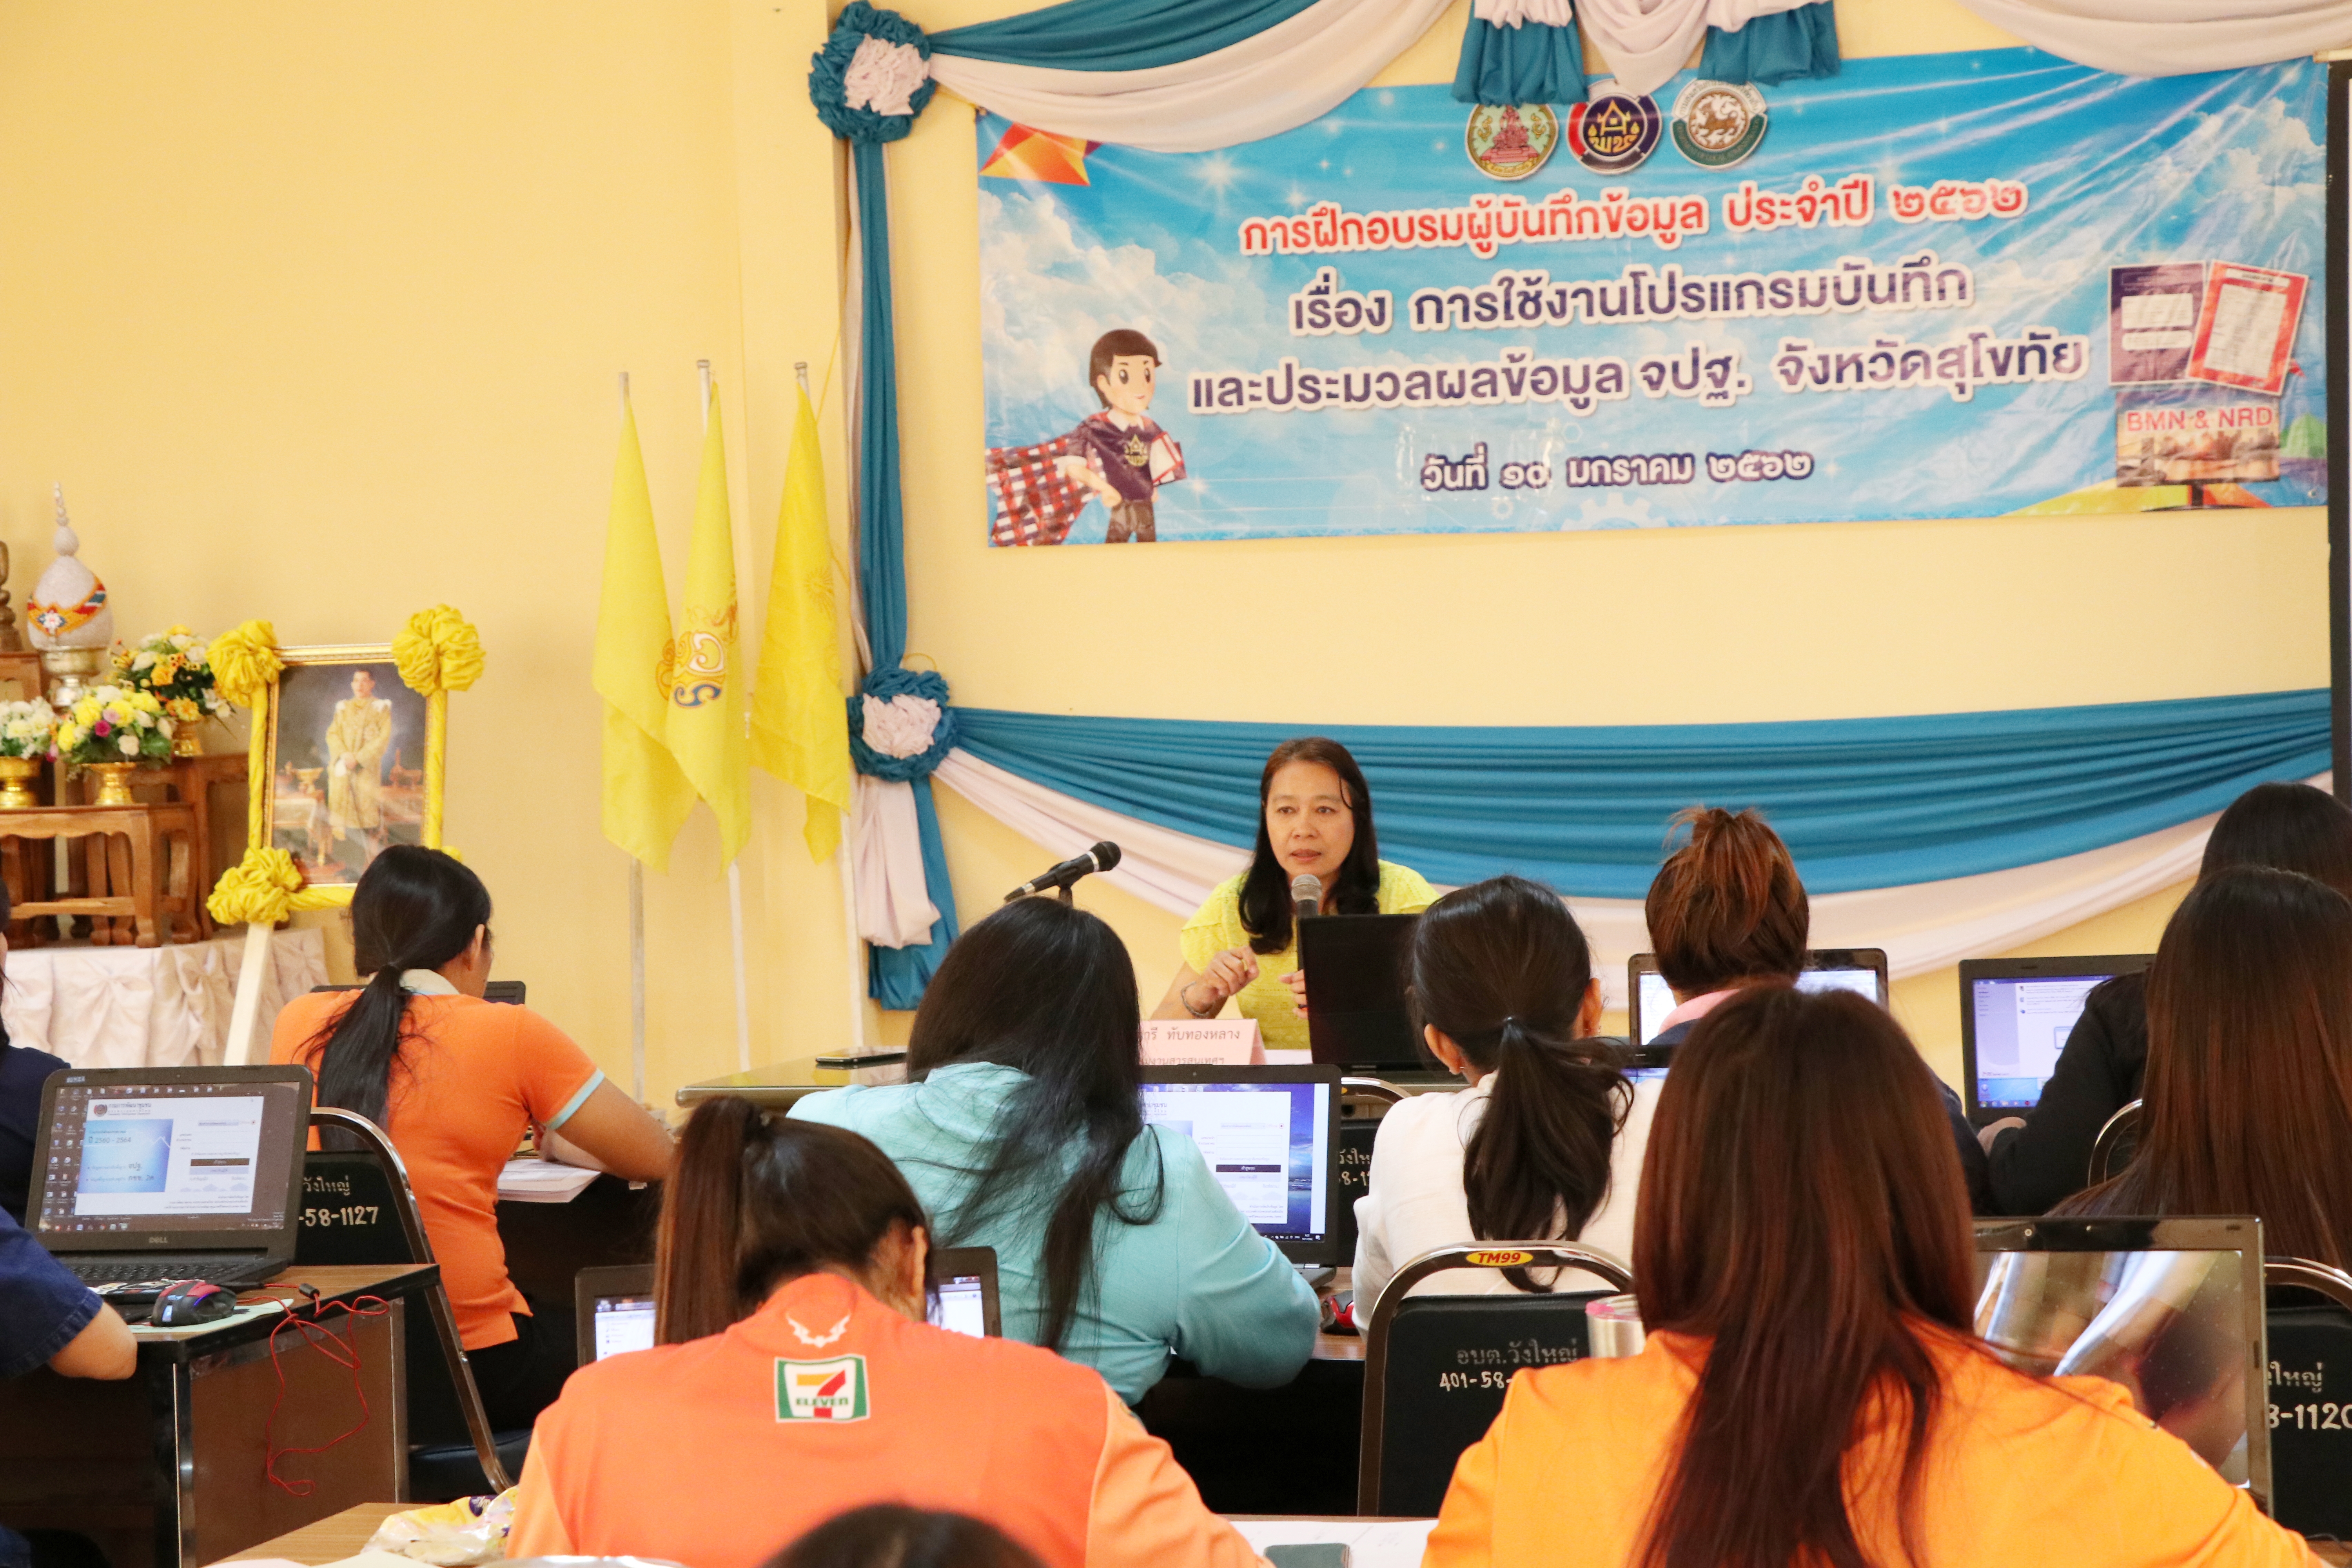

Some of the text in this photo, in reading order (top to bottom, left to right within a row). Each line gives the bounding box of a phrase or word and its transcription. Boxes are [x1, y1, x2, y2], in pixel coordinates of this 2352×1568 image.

[1245, 179, 2024, 253] การฝึกอบรมผู้บันทึกข้อมูล ประจำปี ๒๕๖๒
[1295, 259, 1968, 329] เรื่อง การใช้งานโปรแกรมบันทึก
[1193, 332, 2082, 410] และประมวลผลข้อมูล จปฐ. จังหวัดสุโขทัย
[2127, 406, 2273, 431] BMN & NRD
[1423, 444, 1813, 490] วันที่ ๑๐ มกราคม ๒๕๖๒
[1167, 1026, 1240, 1040] ทับทองหลาง
[1477, 1252, 1521, 1264] TM99
[1457, 1338, 1578, 1365] อบต.วังใหญ่
[2269, 1361, 2323, 1393] ใหญ่
